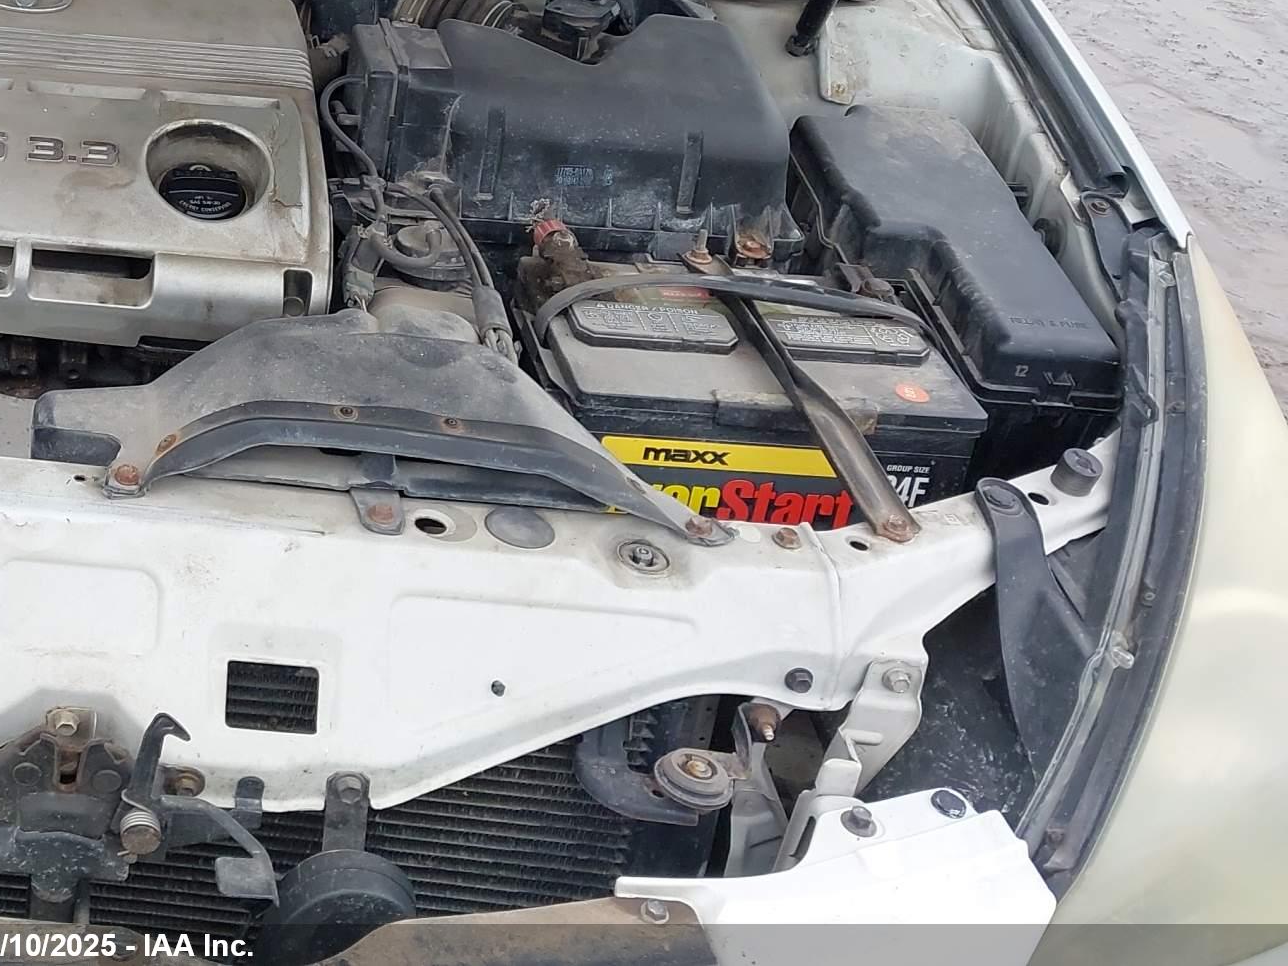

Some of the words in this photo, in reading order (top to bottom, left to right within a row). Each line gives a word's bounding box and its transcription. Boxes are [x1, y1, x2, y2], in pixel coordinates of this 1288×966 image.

[26, 135, 119, 167] 3.3
[607, 303, 649, 311] DANGER
[659, 306, 698, 315] POISON
[886, 464, 913, 473] GROUP
